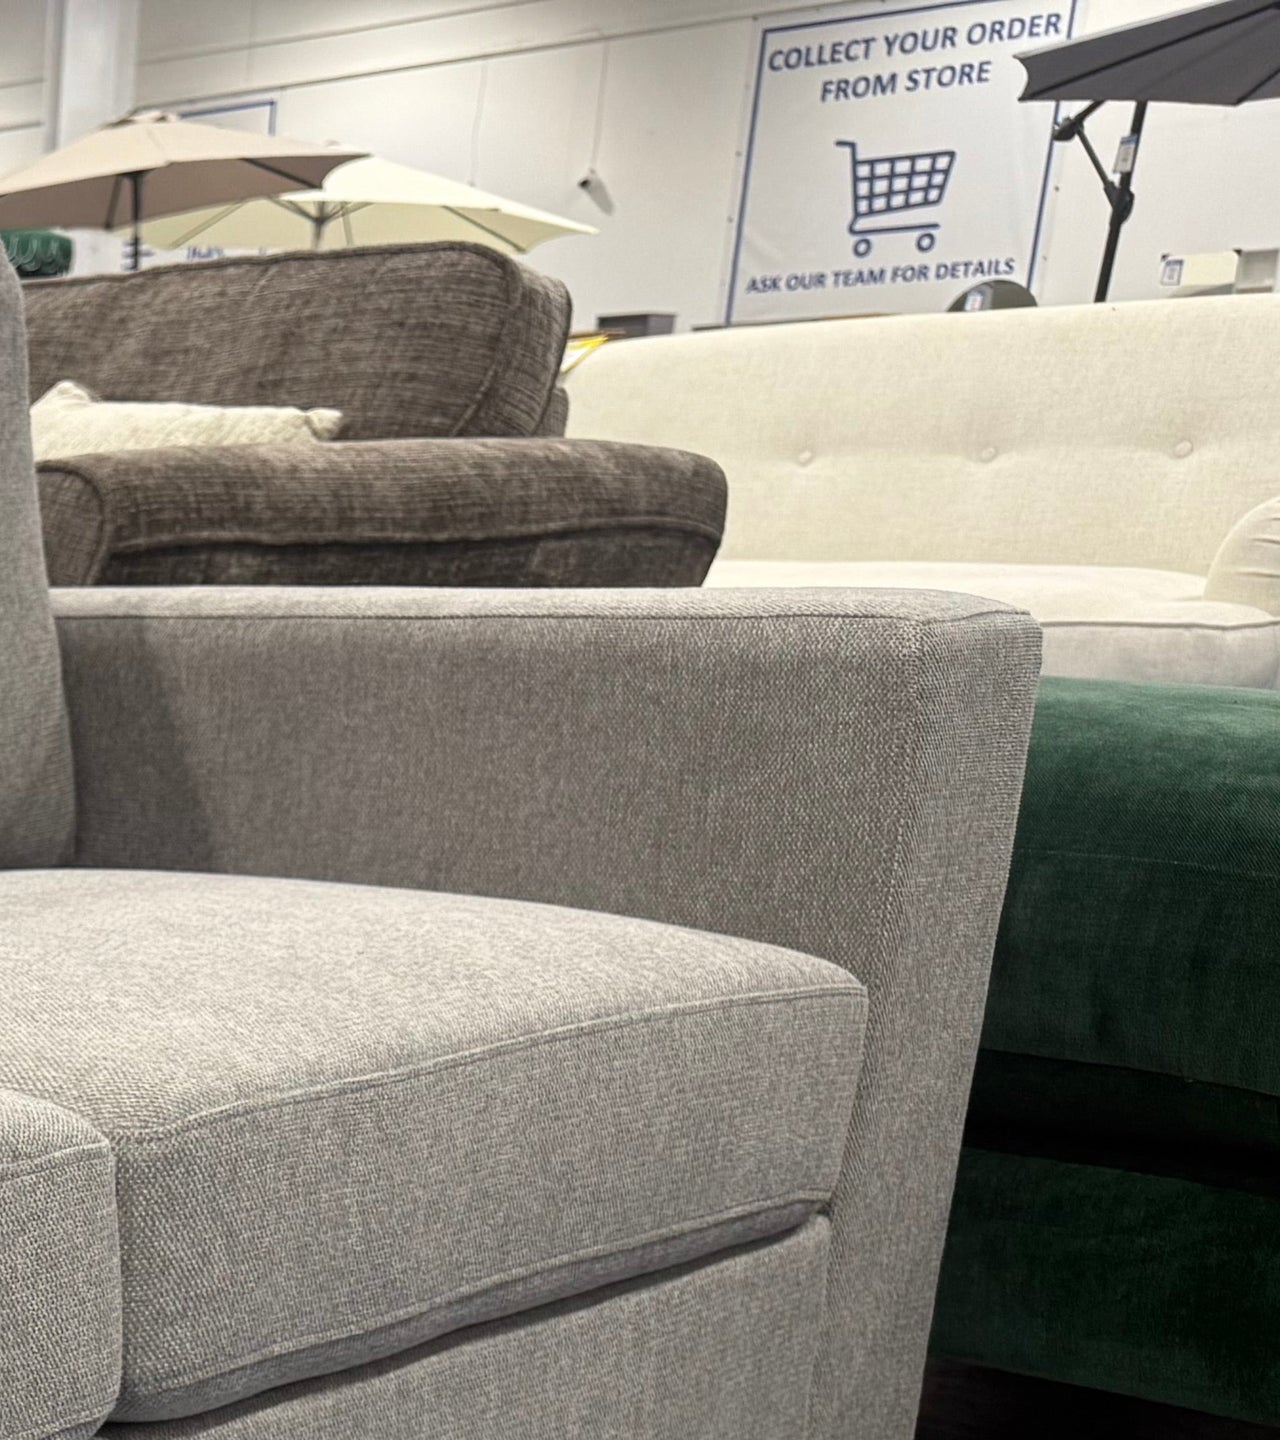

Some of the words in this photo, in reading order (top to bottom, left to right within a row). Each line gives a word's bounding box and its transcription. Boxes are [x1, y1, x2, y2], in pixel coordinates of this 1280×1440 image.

[768, 38, 875, 72] COLLECT
[886, 25, 959, 58] YOUR
[966, 13, 1061, 47] ORDER
[820, 73, 898, 102] FROM
[905, 60, 992, 92] STORE
[746, 277, 781, 294] ASK
[785, 272, 826, 291] OUR
[831, 268, 888, 288] TEAM
[891, 264, 929, 283] FOR
[934, 256, 1015, 281] DETAILS
